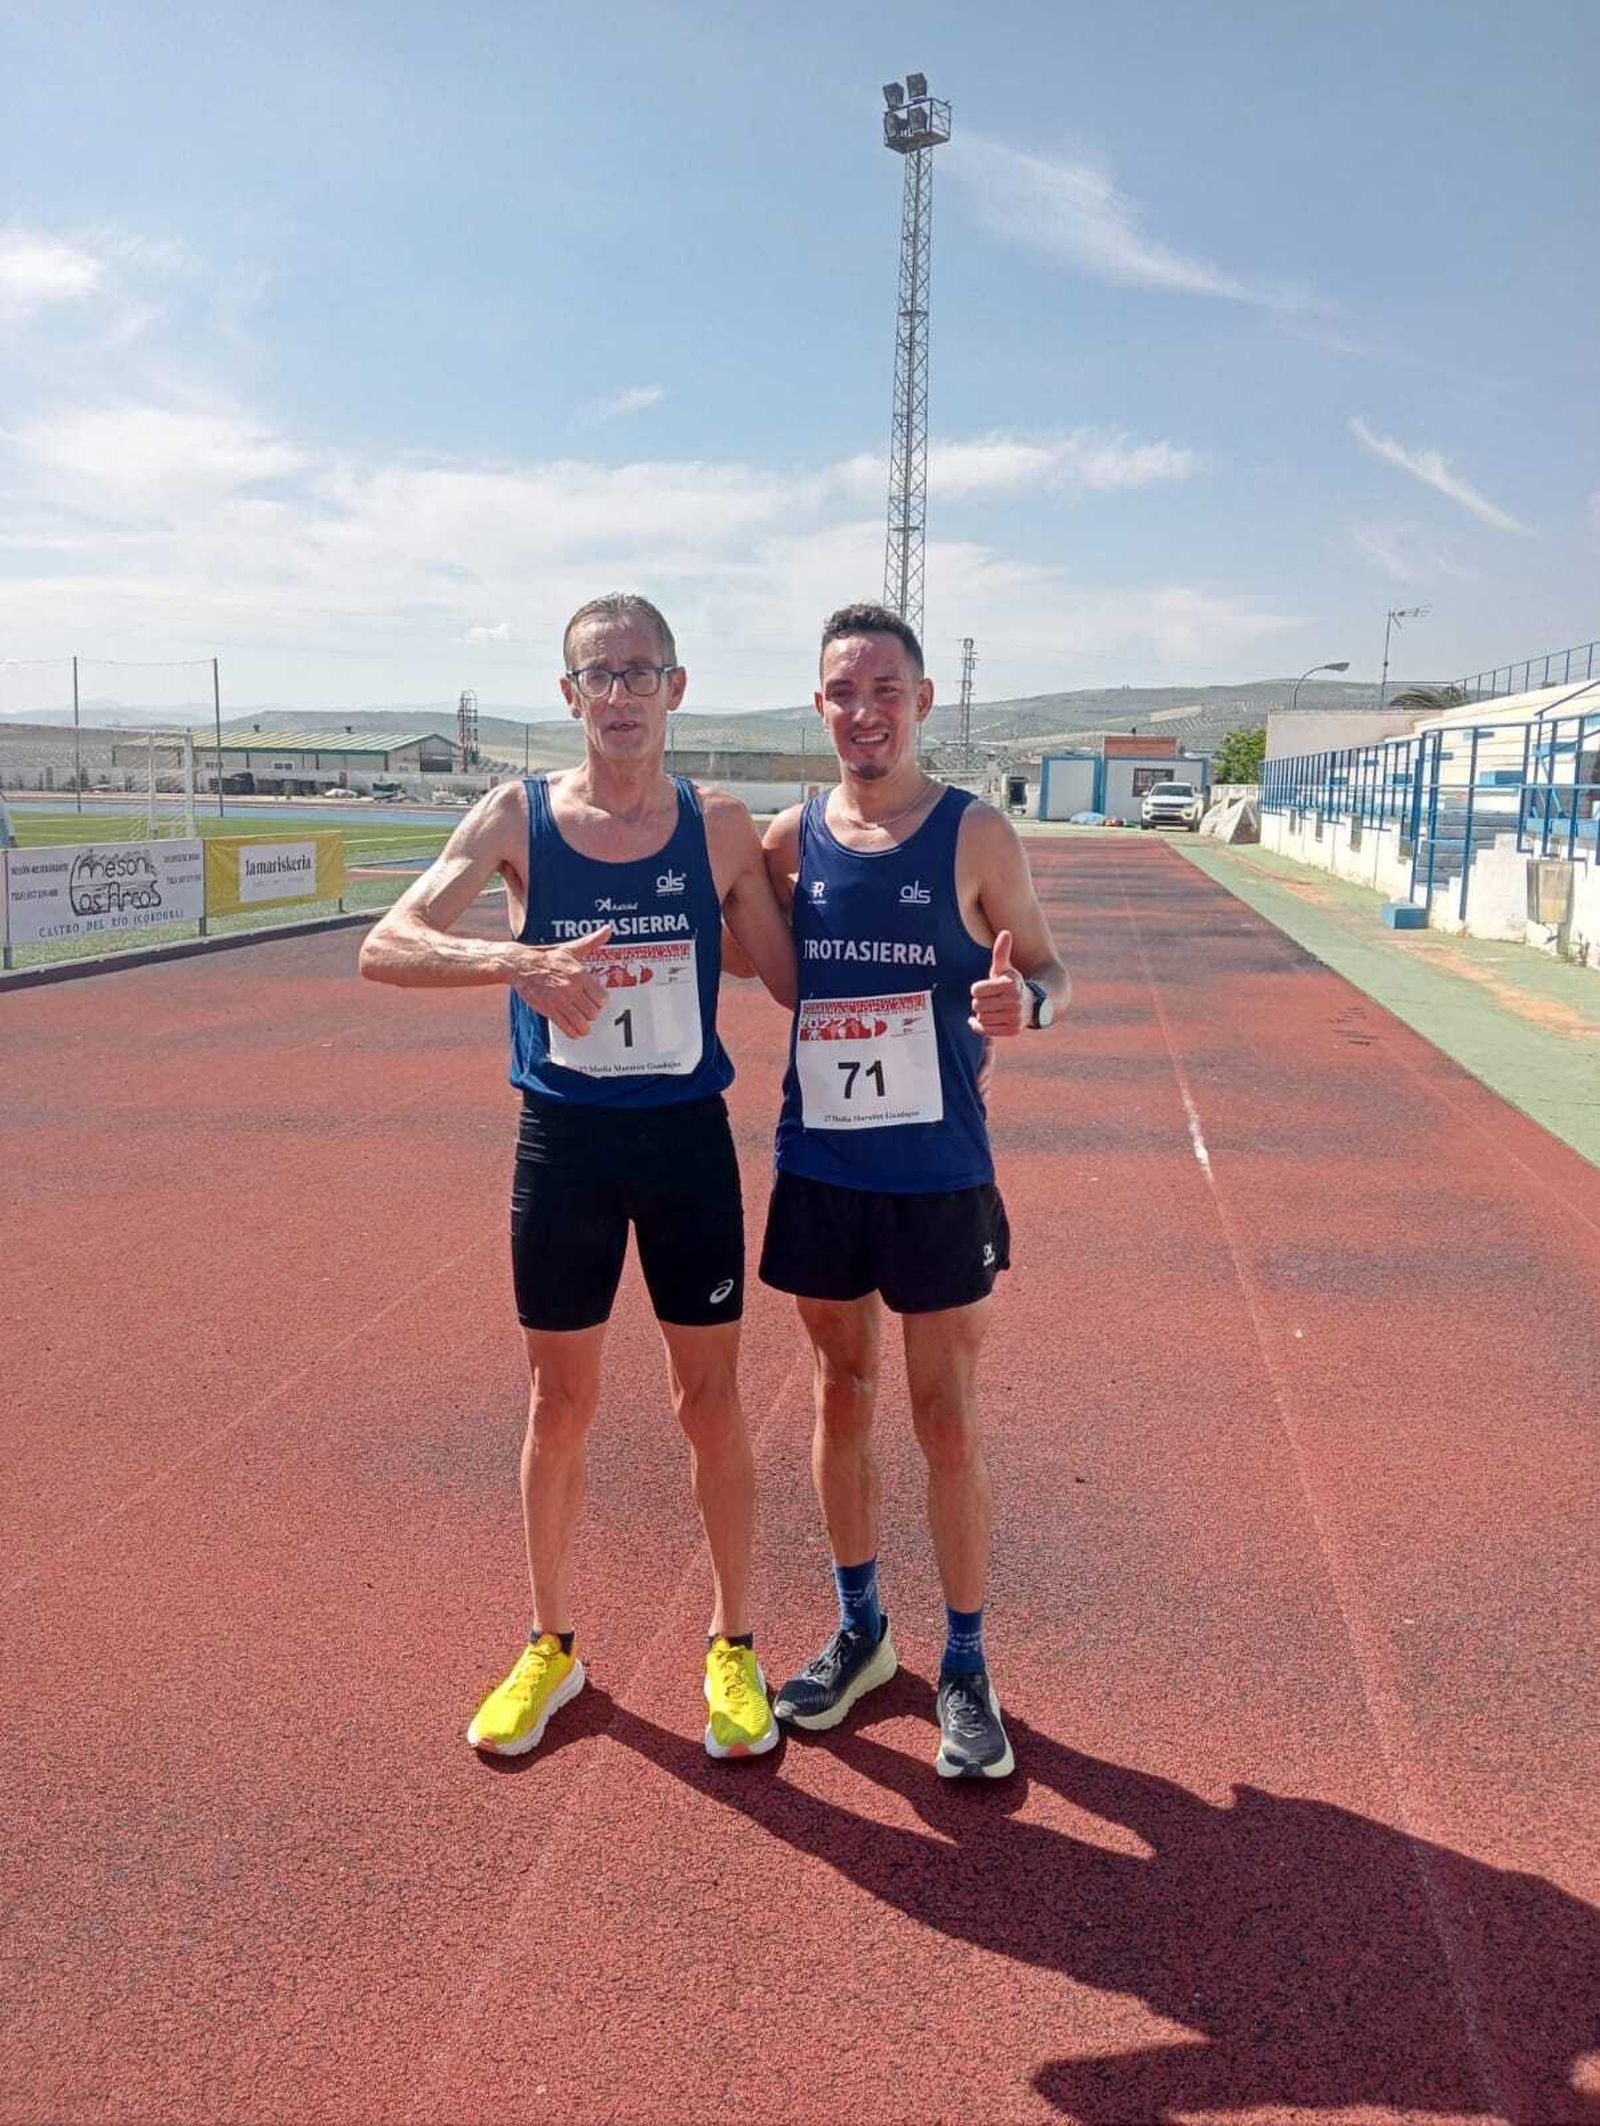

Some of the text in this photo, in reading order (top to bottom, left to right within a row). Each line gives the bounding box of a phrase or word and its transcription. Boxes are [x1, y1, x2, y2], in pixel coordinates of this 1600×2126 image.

[38, 923, 80, 938] CASTRO
[86, 919, 105, 932] DEL
[552, 913, 690, 938] TROTASIERRA
[613, 1009, 634, 1048] 1
[837, 1060, 886, 1099] 71
